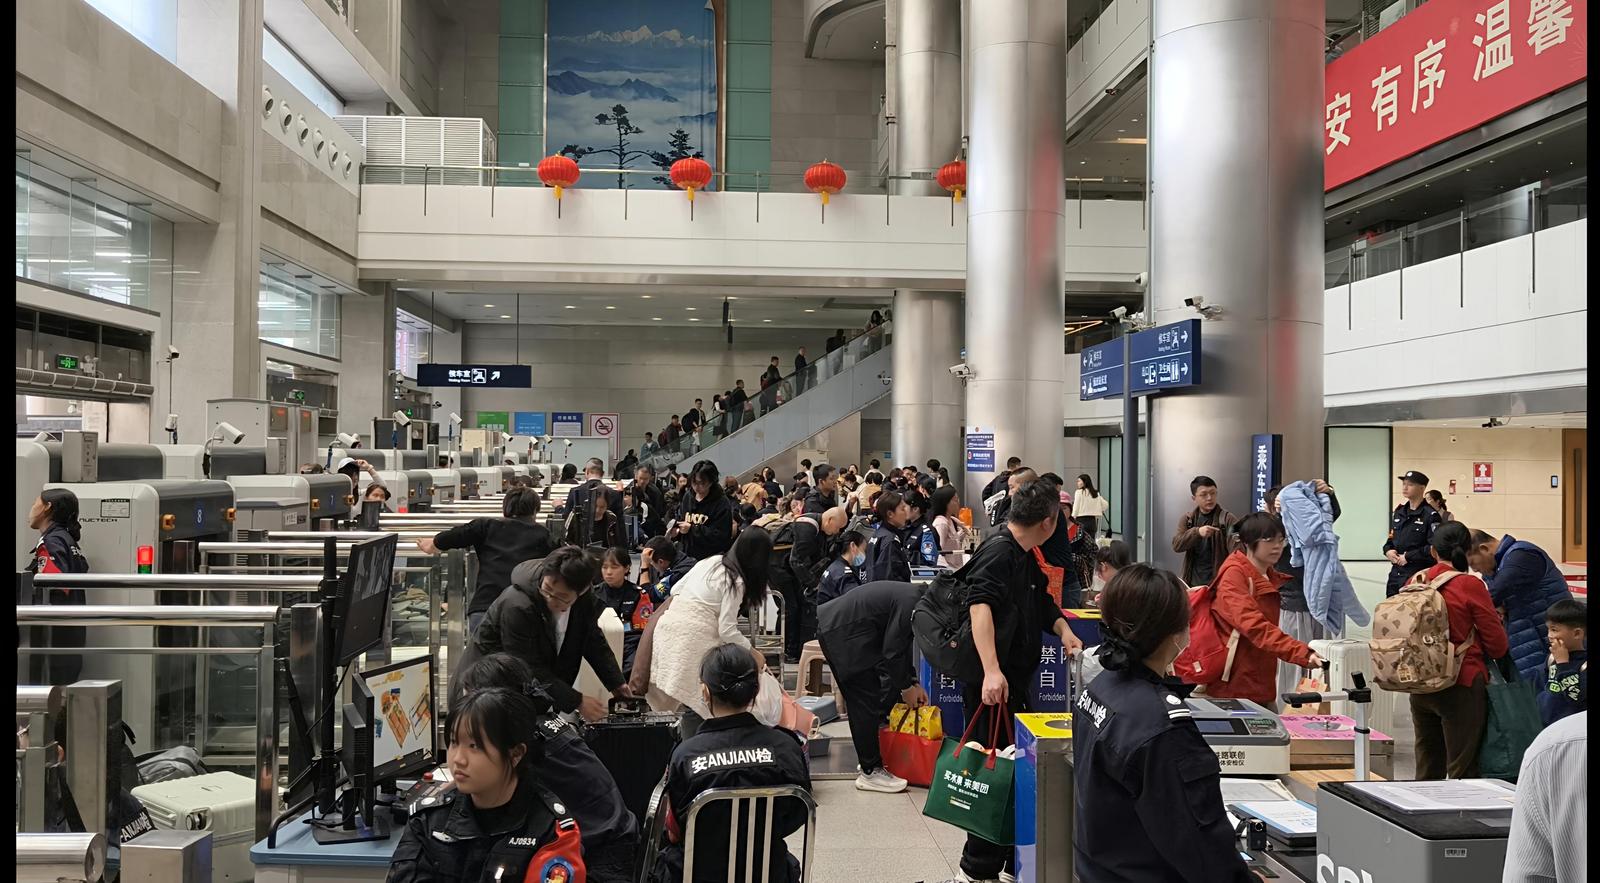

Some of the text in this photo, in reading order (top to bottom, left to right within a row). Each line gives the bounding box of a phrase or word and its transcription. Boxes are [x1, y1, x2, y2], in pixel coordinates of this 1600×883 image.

[1326, 91, 1351, 156] 安
[691, 748, 773, 774] 安ANJIAN检
[120, 811, 152, 841] ANJIAN检
